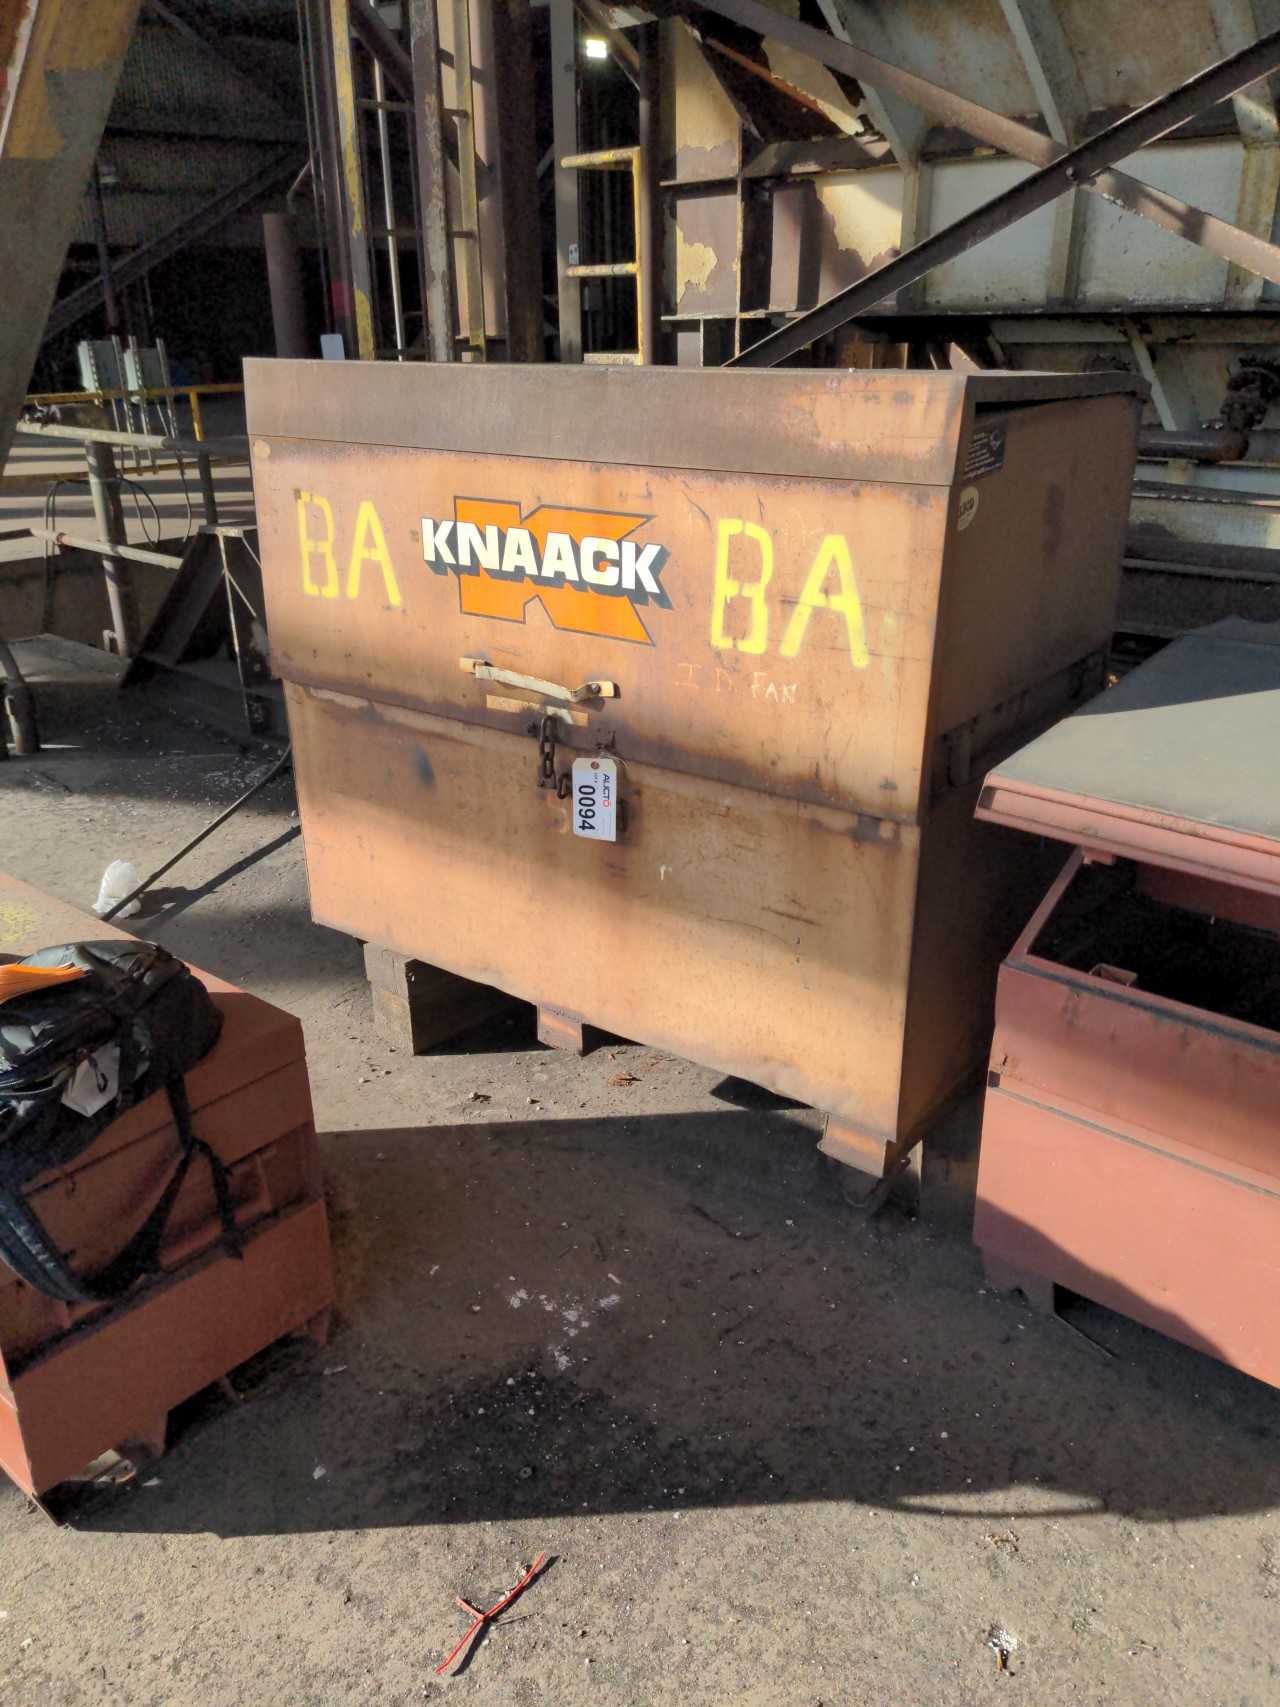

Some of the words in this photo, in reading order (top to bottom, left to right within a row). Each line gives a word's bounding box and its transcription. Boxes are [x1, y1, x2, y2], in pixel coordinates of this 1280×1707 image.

[297, 490, 403, 607] BA
[420, 517, 667, 598] KNAACK
[710, 518, 871, 669] BA
[578, 785, 596, 831] 0094
[602, 773, 612, 808] AUCTO
